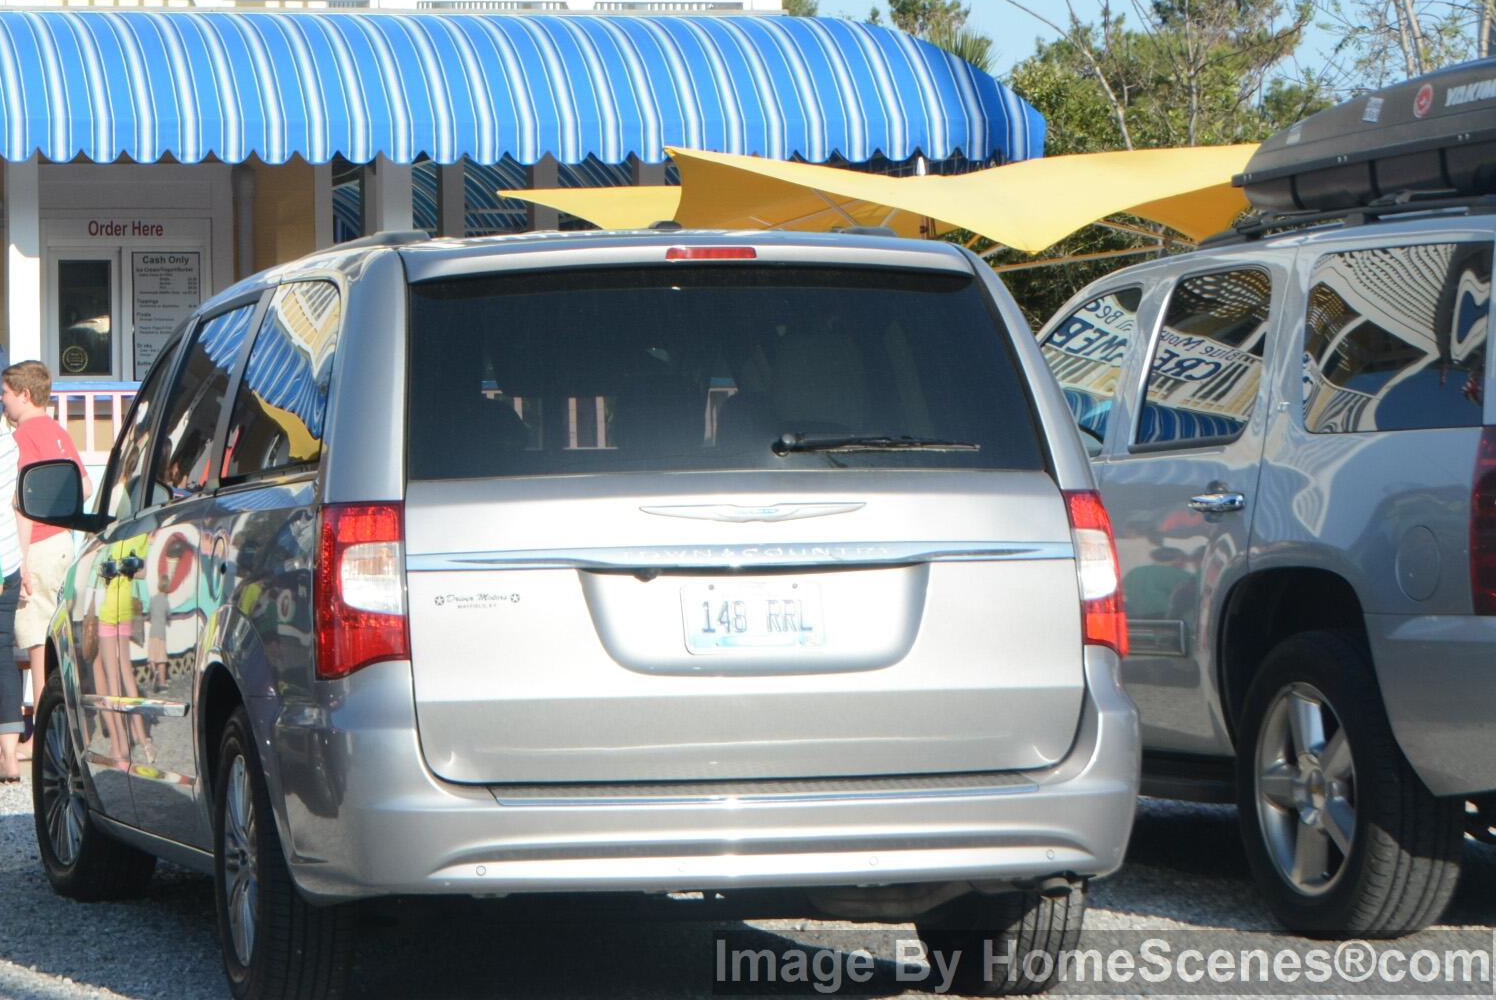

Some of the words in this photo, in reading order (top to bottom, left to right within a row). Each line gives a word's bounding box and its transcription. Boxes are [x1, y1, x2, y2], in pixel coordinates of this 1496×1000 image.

[88, 220, 127, 237] Order
[132, 221, 164, 237] Here
[142, 255, 166, 264] Cash
[168, 255, 190, 266] Only
